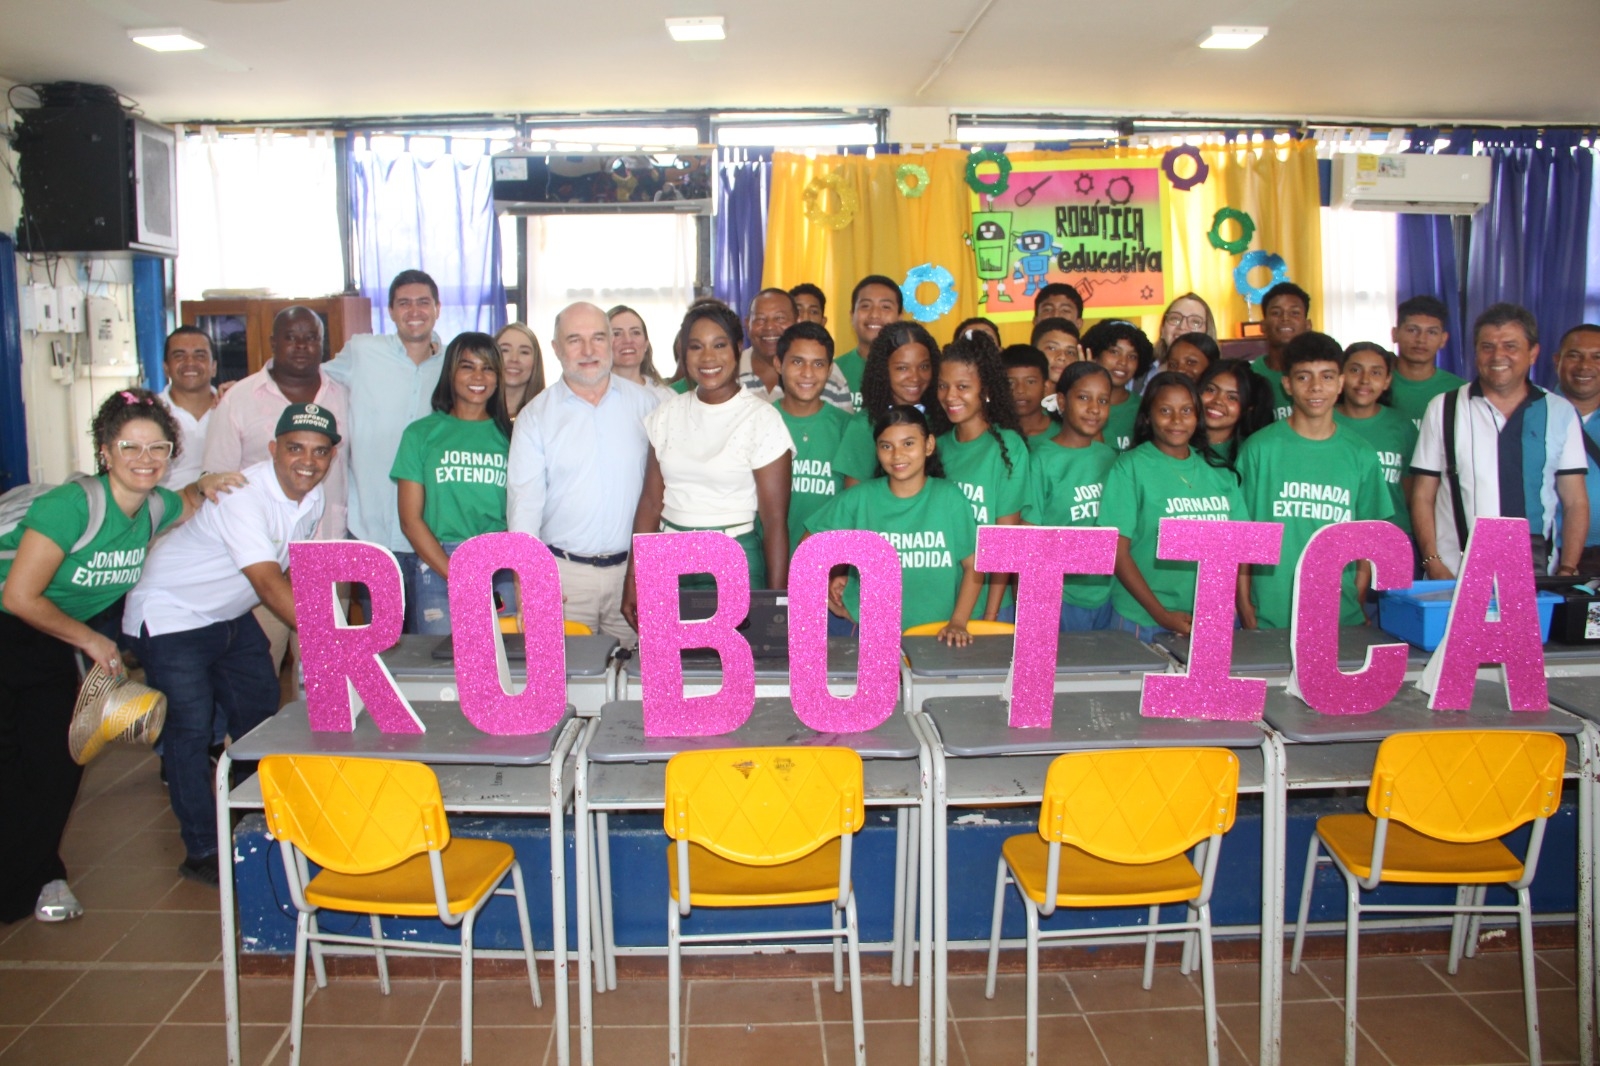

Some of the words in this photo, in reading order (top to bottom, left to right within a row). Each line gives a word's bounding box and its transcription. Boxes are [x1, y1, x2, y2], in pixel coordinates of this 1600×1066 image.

[1057, 242, 1163, 274] educativa
[435, 465, 507, 488] EXTENDID
[791, 476, 836, 496] NDIDA
[1165, 495, 1231, 514] JORNADA
[1279, 481, 1350, 506] JORNADA
[71, 566, 141, 587] EXTENDID
[288, 516, 1550, 738] ROBOTICA
